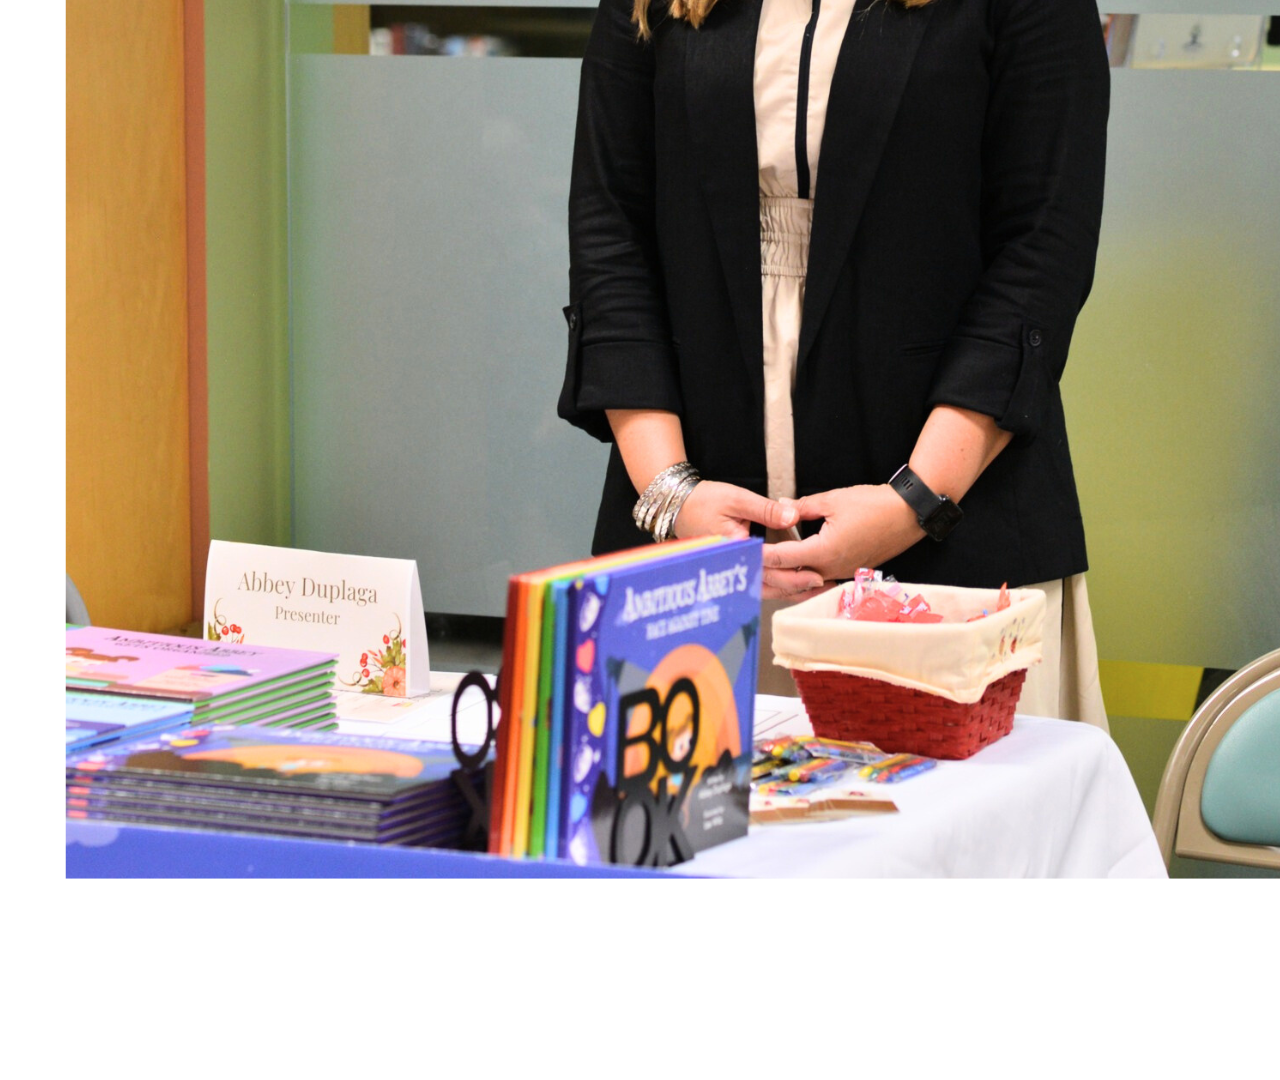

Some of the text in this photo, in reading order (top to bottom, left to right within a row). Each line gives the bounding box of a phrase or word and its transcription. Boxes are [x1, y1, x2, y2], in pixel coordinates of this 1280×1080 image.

[237, 571, 379, 608] Abbey Duplaga
[275, 605, 341, 626] Presenter
